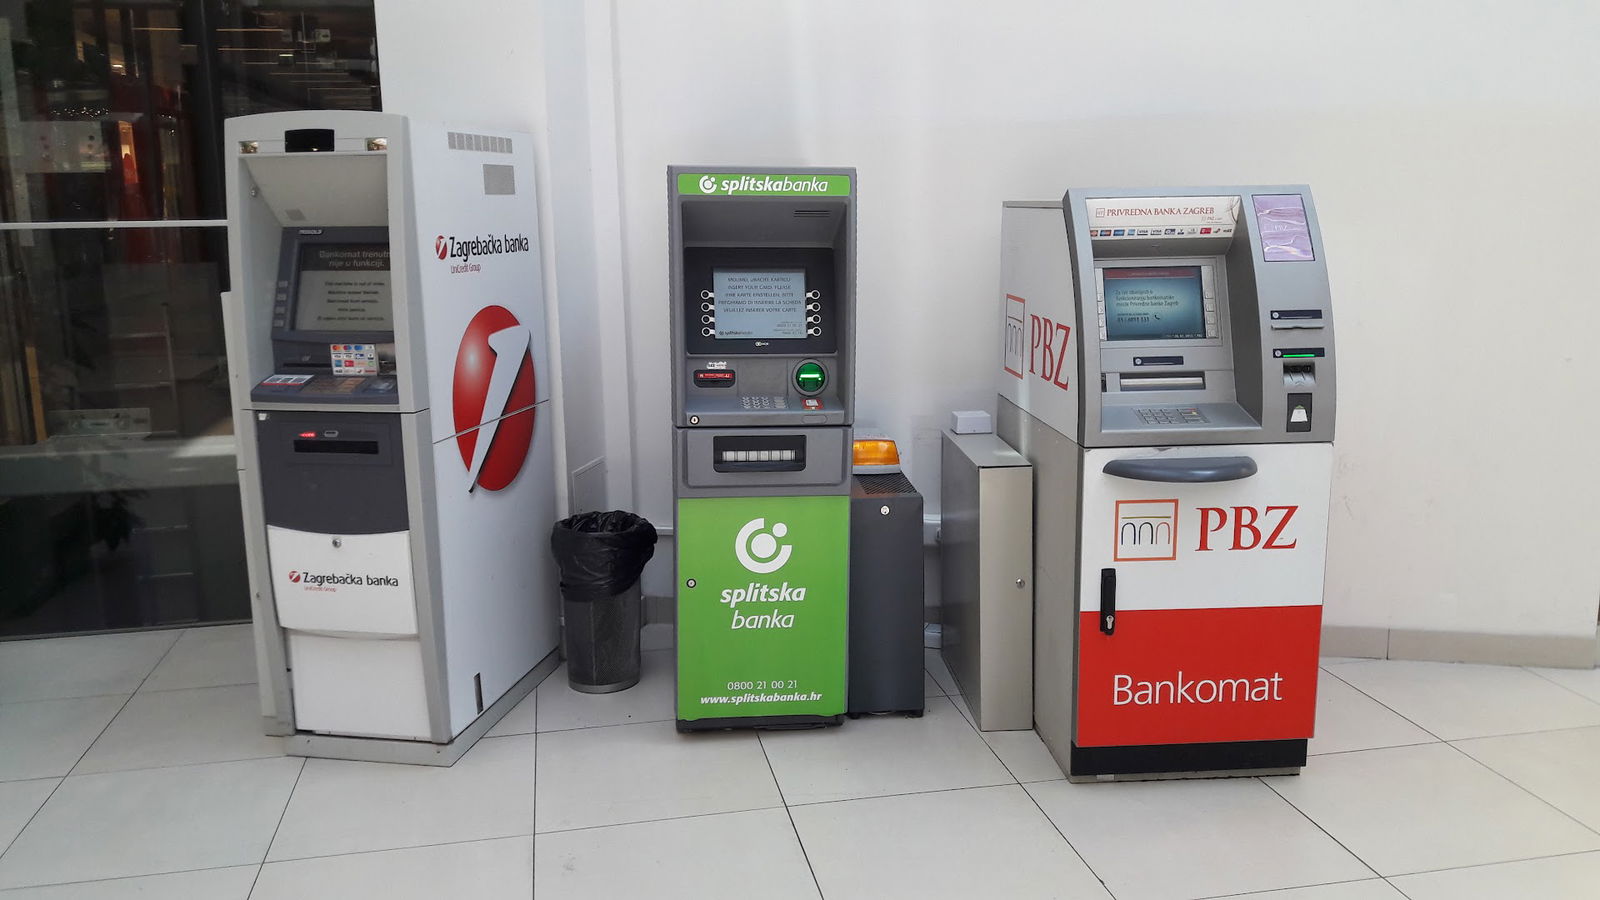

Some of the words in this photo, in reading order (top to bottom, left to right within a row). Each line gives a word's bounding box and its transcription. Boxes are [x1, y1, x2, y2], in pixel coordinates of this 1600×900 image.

[720, 176, 828, 195] splitskabanka
[1106, 207, 1153, 217] PRIVREDNA
[1154, 207, 1182, 216] BANKA
[1183, 206, 1215, 216] ZAGREB
[449, 233, 503, 262] Zagrebačka
[504, 233, 529, 254] banka
[1028, 313, 1071, 391] PBZ
[1194, 505, 1300, 552] PBZ
[302, 571, 363, 587] Zagrebačka
[366, 574, 399, 587] banka
[719, 581, 807, 609] splitska
[731, 609, 795, 630] banka
[727, 681, 754, 691] 0800
[756, 680, 767, 690] 21
[771, 680, 784, 690] 00
[787, 679, 798, 689] 21
[1112, 670, 1284, 706] Bankomat
[700, 691, 823, 706] www.splitskabanka.hr
